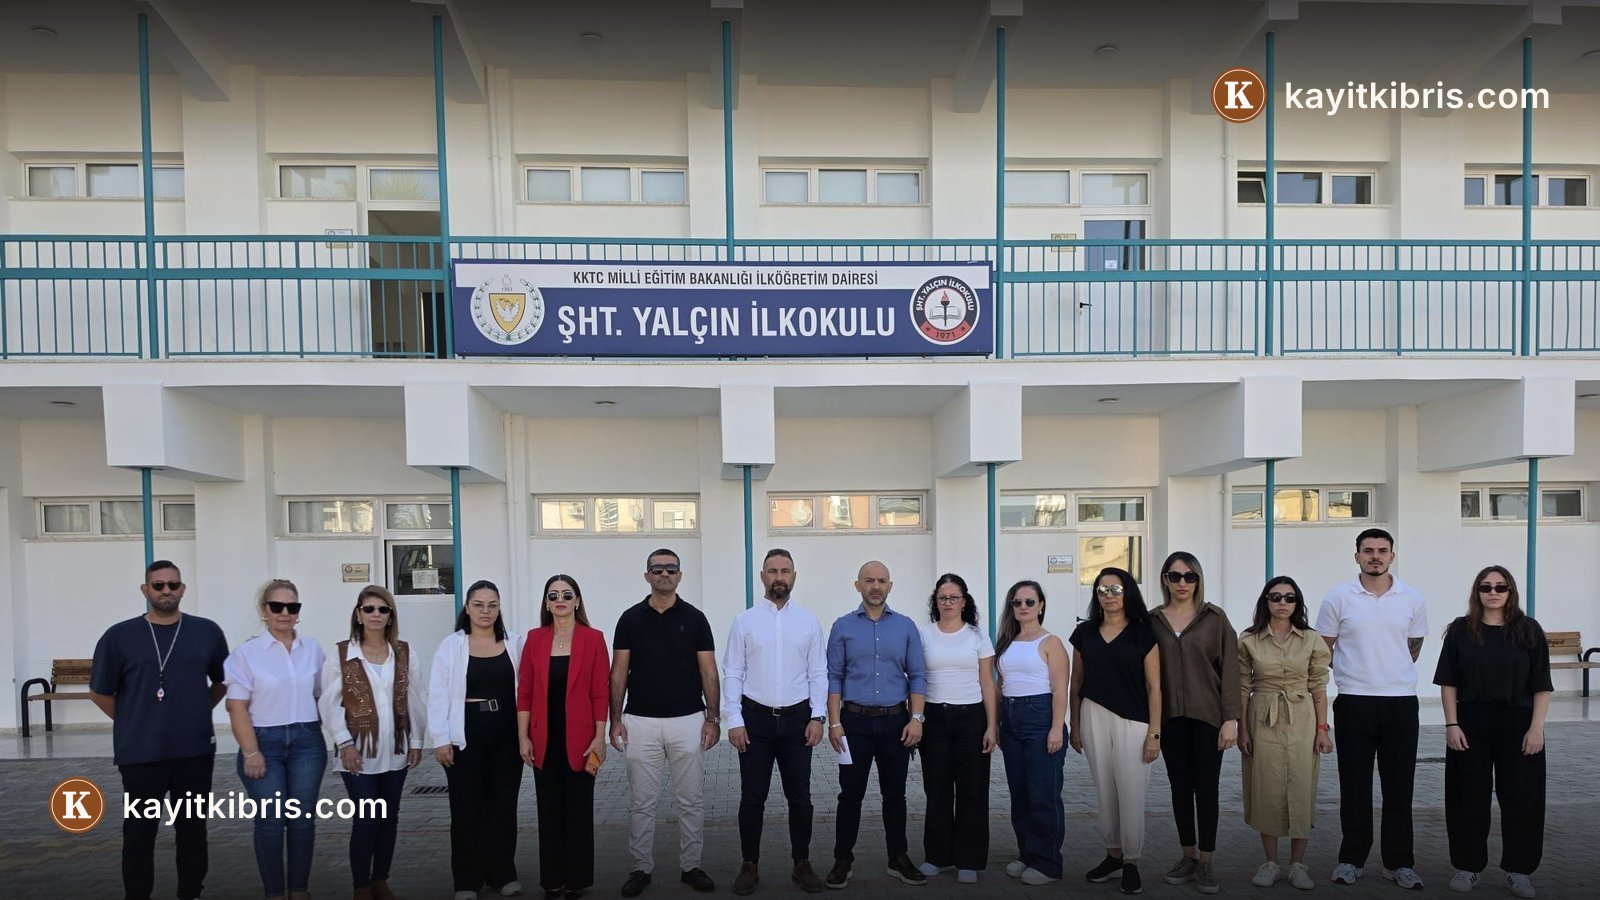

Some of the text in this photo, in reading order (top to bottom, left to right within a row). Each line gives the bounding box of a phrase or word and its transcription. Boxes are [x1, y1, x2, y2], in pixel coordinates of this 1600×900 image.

[573, 269, 878, 285] KKTC MİLLİ EĞİTİM BAKANLIĞI İLKÖĞRETİM DAİRESİ
[915, 278, 975, 311] ŞHT. YALÇIN İLKOKULU
[558, 300, 895, 344] ŞHT. YALÇIN İLKOKULU
[935, 331, 956, 339] 1971
